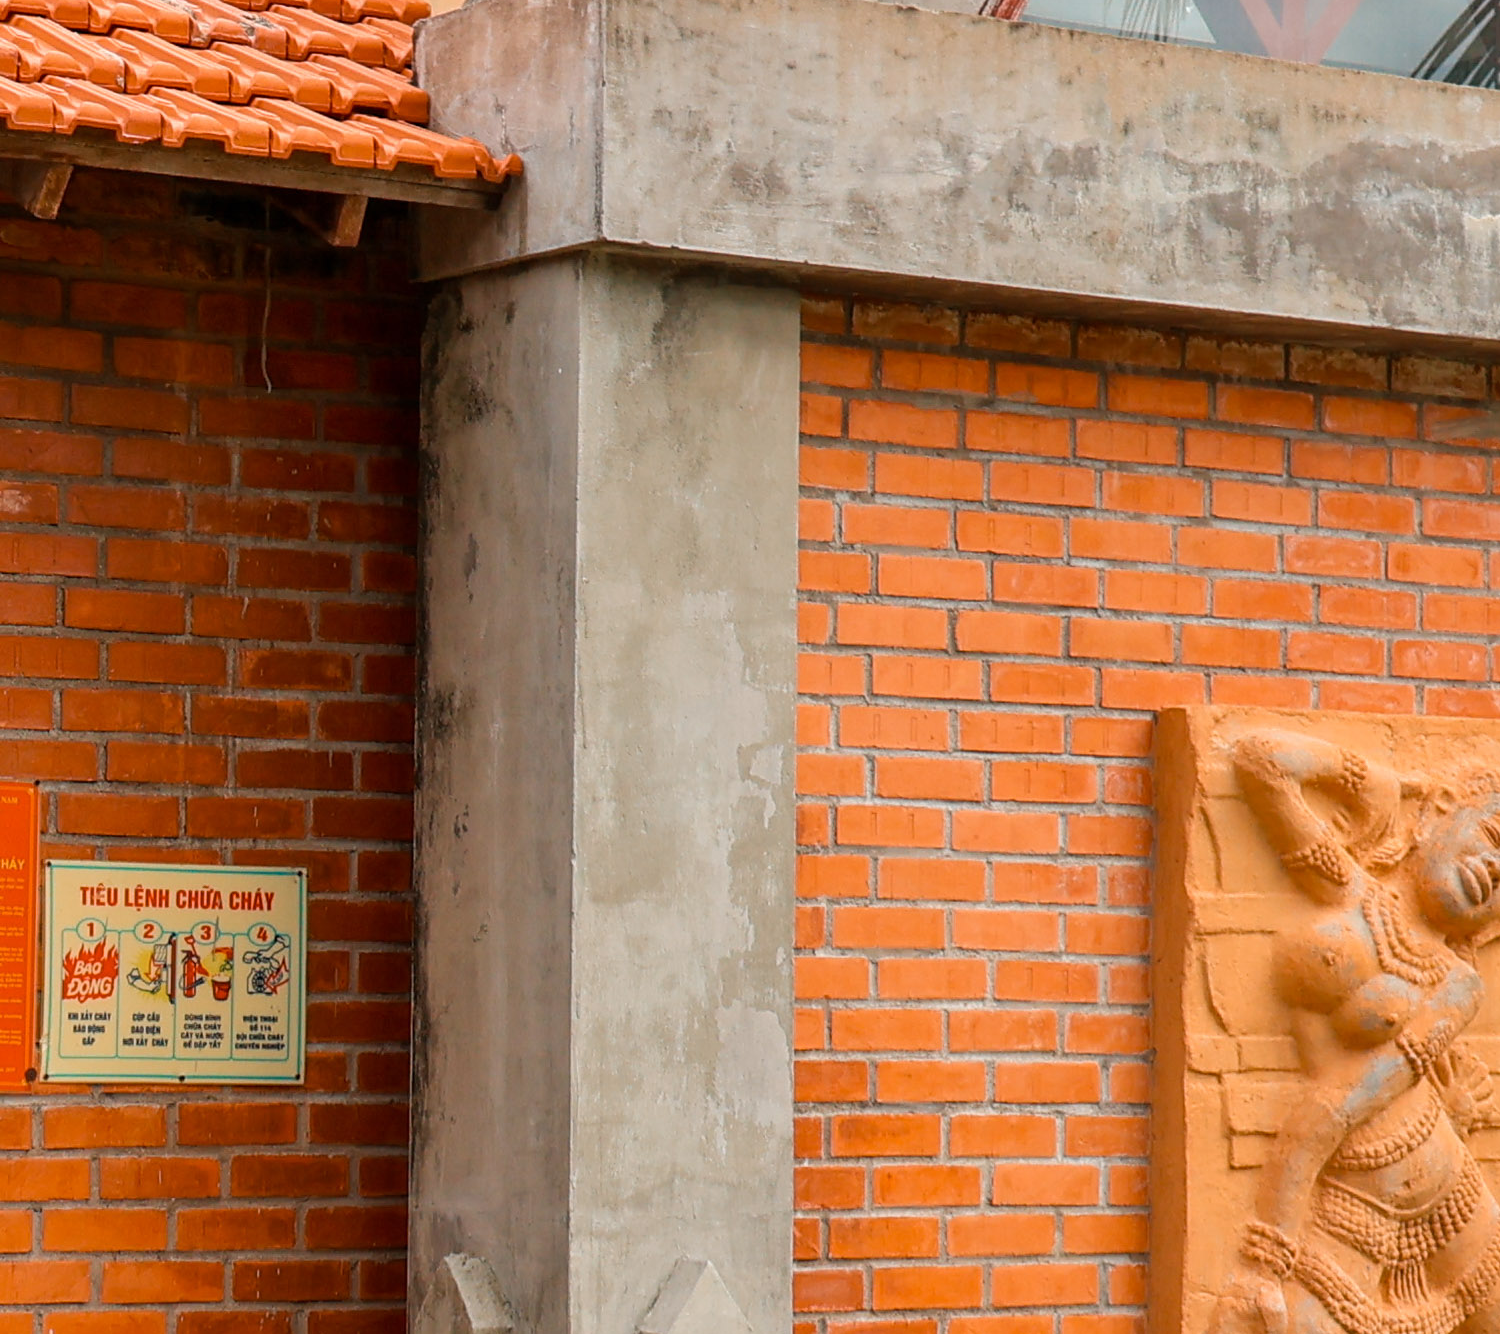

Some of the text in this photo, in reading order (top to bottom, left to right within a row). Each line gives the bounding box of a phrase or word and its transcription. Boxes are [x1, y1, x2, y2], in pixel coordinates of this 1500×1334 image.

[80, 883, 274, 912] TIÊU LỆNH CHỮA CHÁY
[87, 922, 94, 937] 1
[143, 923, 155, 939] 2
[200, 925, 211, 940] 3
[257, 927, 268, 942] 4
[74, 958, 102, 975] BÁO
[67, 975, 113, 999] ĐỘNG
